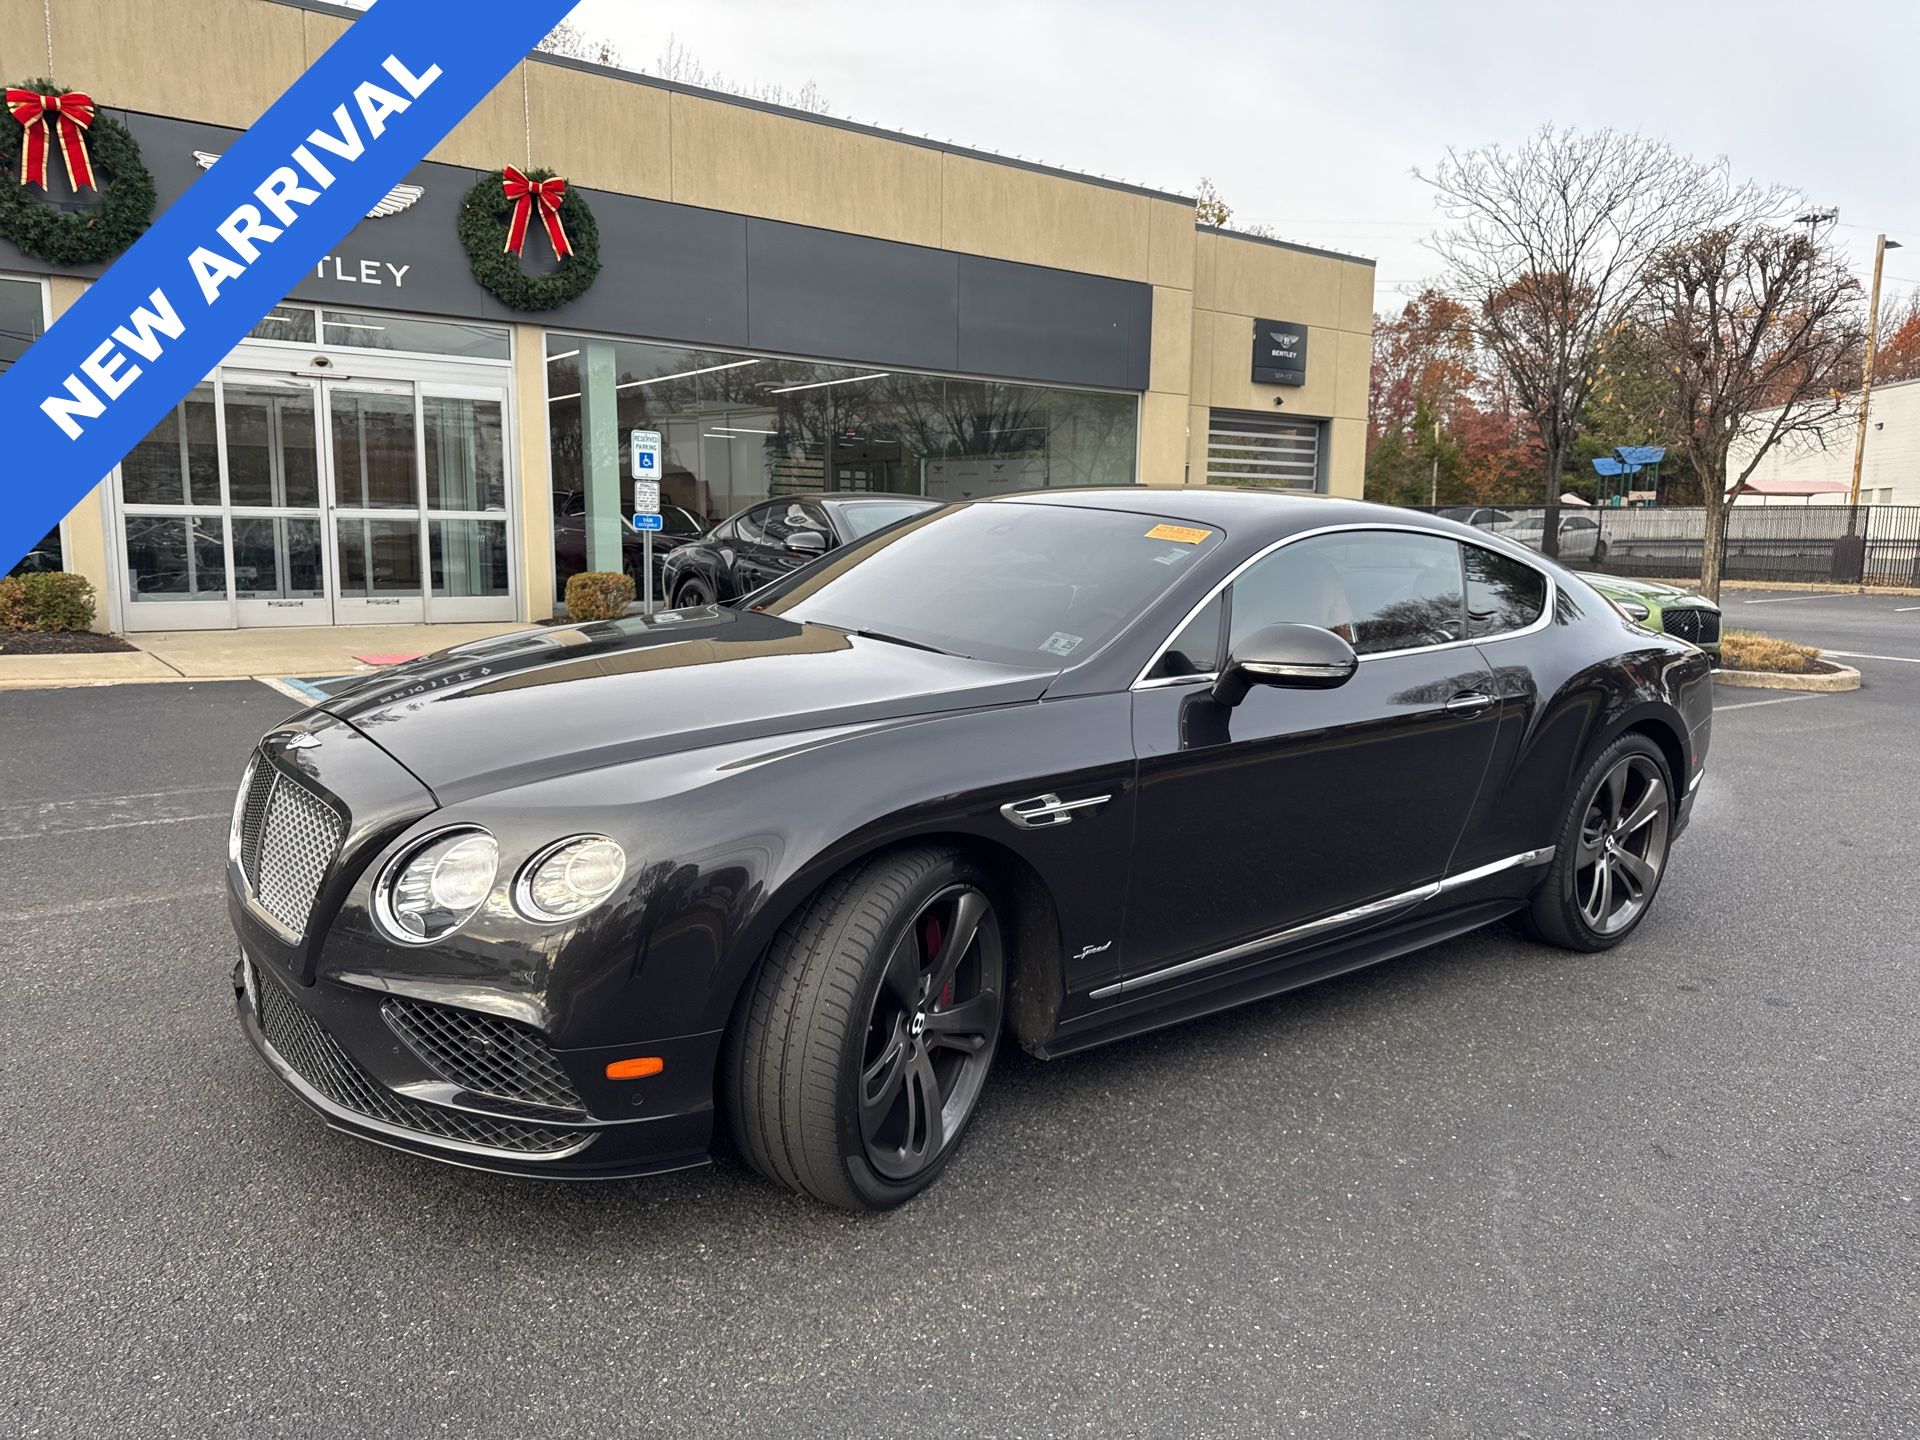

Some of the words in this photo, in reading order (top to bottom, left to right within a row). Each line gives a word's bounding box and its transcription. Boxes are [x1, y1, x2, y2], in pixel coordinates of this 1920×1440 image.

[317, 255, 410, 287] TLEY
[1271, 349, 1297, 359] BENTLEY
[634, 435, 659, 444] RESERVED
[635, 443, 657, 452] PARKING
[1073, 940, 1112, 960] Speed
